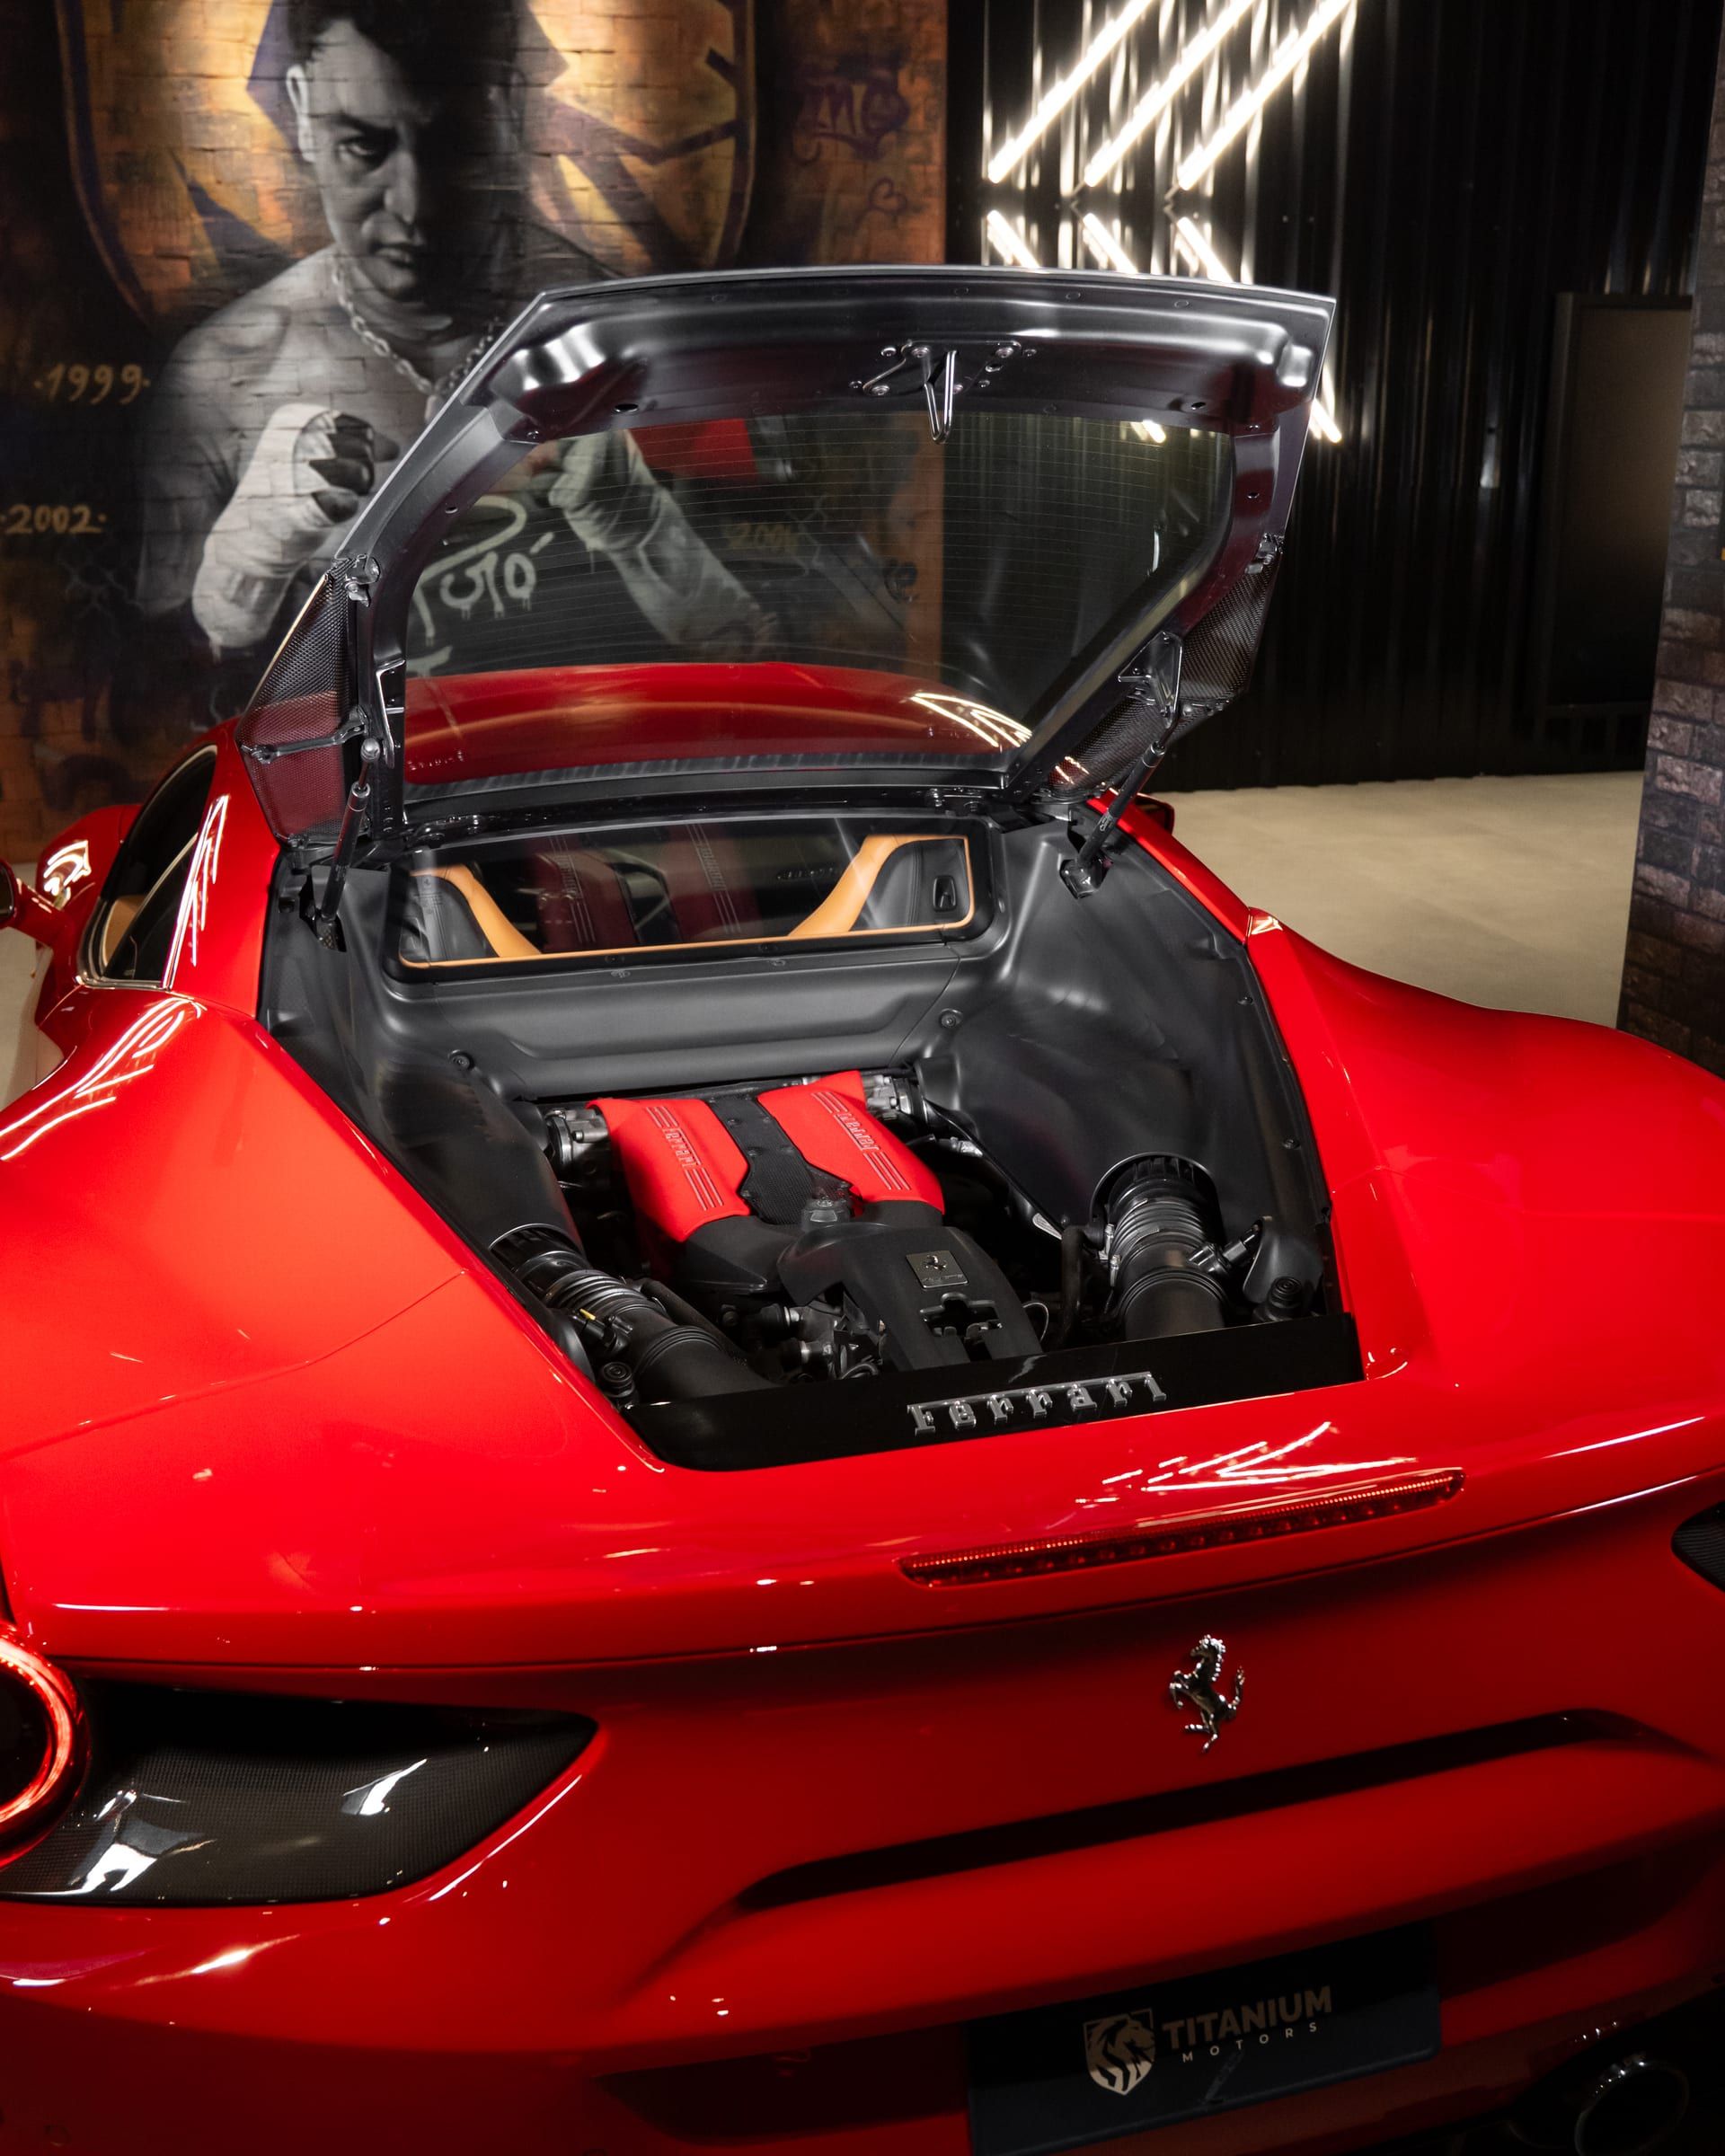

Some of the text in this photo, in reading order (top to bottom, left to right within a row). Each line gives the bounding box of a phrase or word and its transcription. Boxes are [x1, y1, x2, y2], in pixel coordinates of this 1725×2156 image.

[662, 1127, 702, 1168] Ferrari
[832, 1111, 880, 1152] Ferrari
[907, 1371, 1166, 1436] Ferrari
[1162, 1985, 1331, 2050] TITANIUM
[1182, 2021, 1317, 2063] MOTORS
